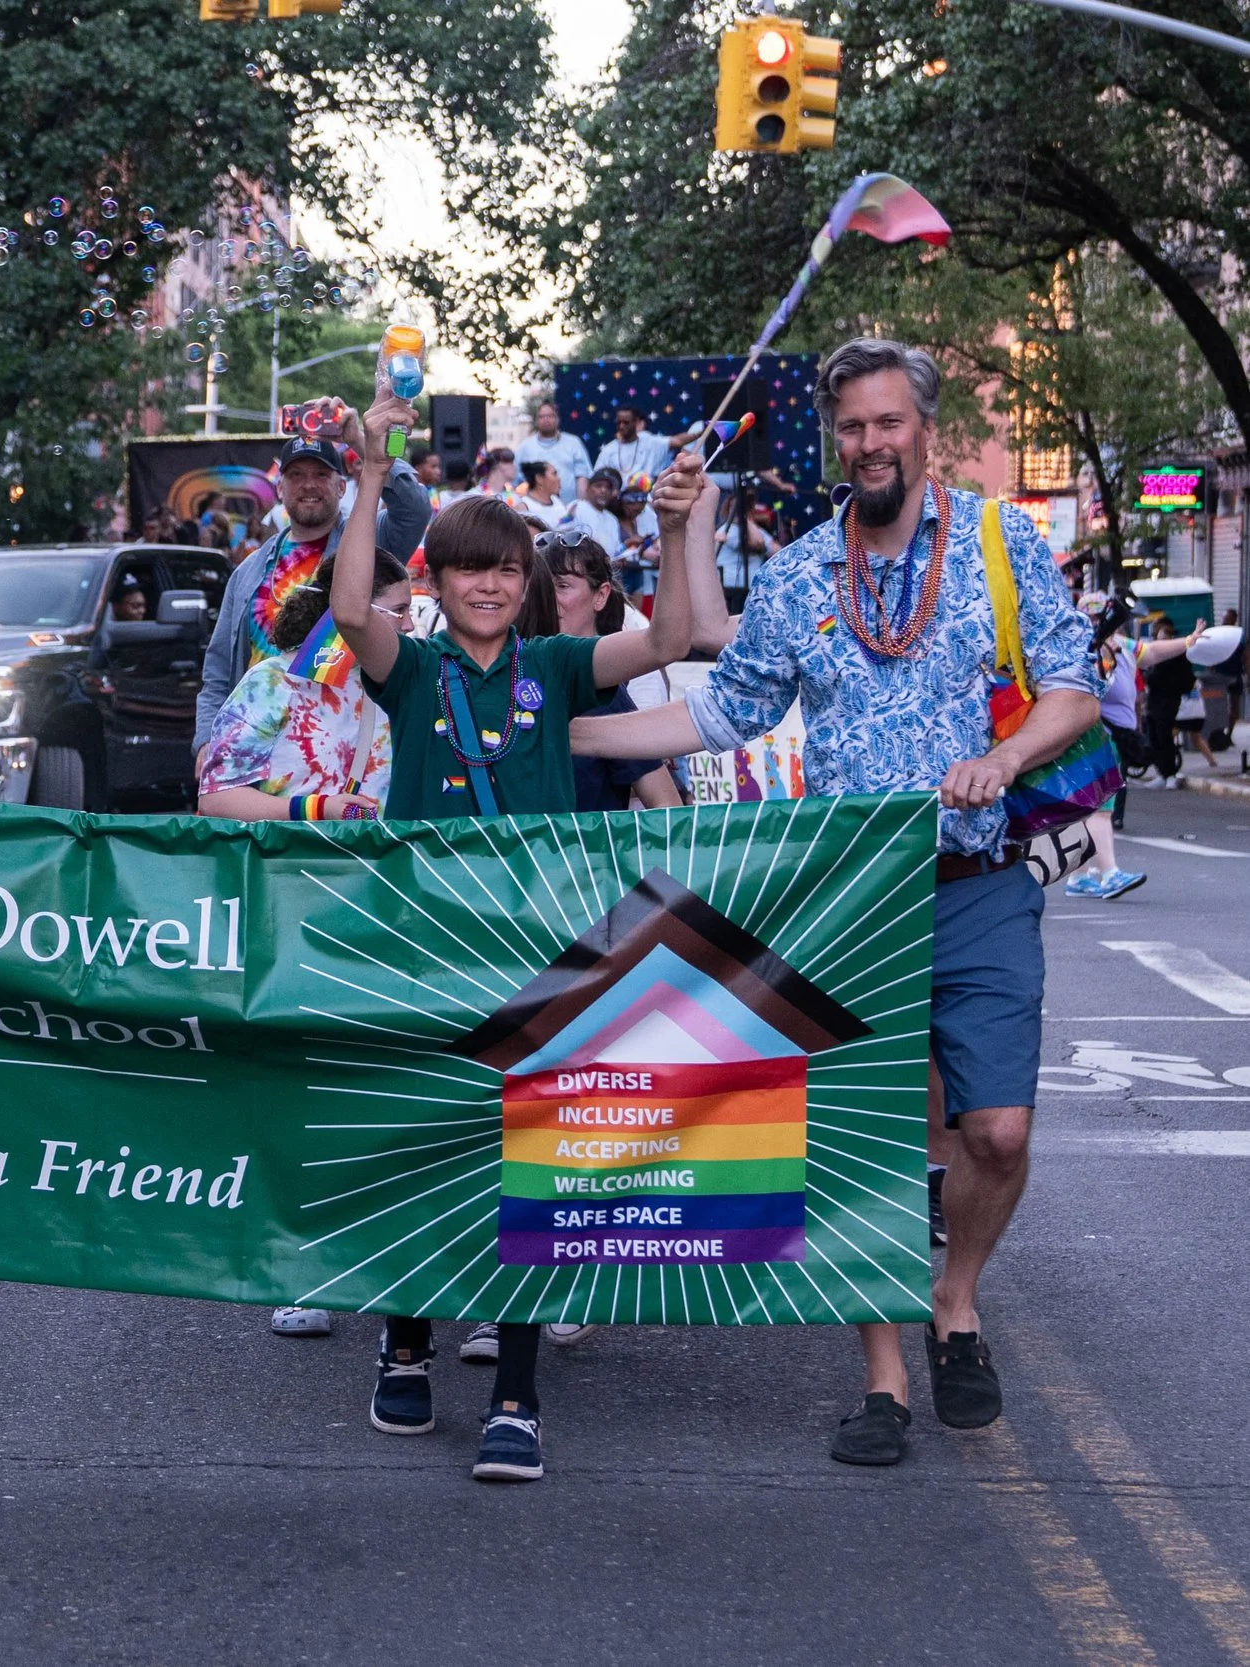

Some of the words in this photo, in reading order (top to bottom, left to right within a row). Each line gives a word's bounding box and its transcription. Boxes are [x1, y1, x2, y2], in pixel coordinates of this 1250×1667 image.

[1138, 474, 1199, 487] VOODOO
[1143, 485, 1194, 496] QUEEN
[557, 1072, 653, 1091] DIVERSE
[558, 1105, 674, 1126] INCLUSIVE
[555, 1136, 680, 1159] ACCEPTING
[30, 1139, 249, 1209] Friend
[554, 1170, 695, 1194] WELCOMING
[553, 1210, 607, 1228] SAFE
[612, 1207, 683, 1226] SPACE
[553, 1240, 597, 1259] FOR
[603, 1239, 724, 1258] EVERYONE
